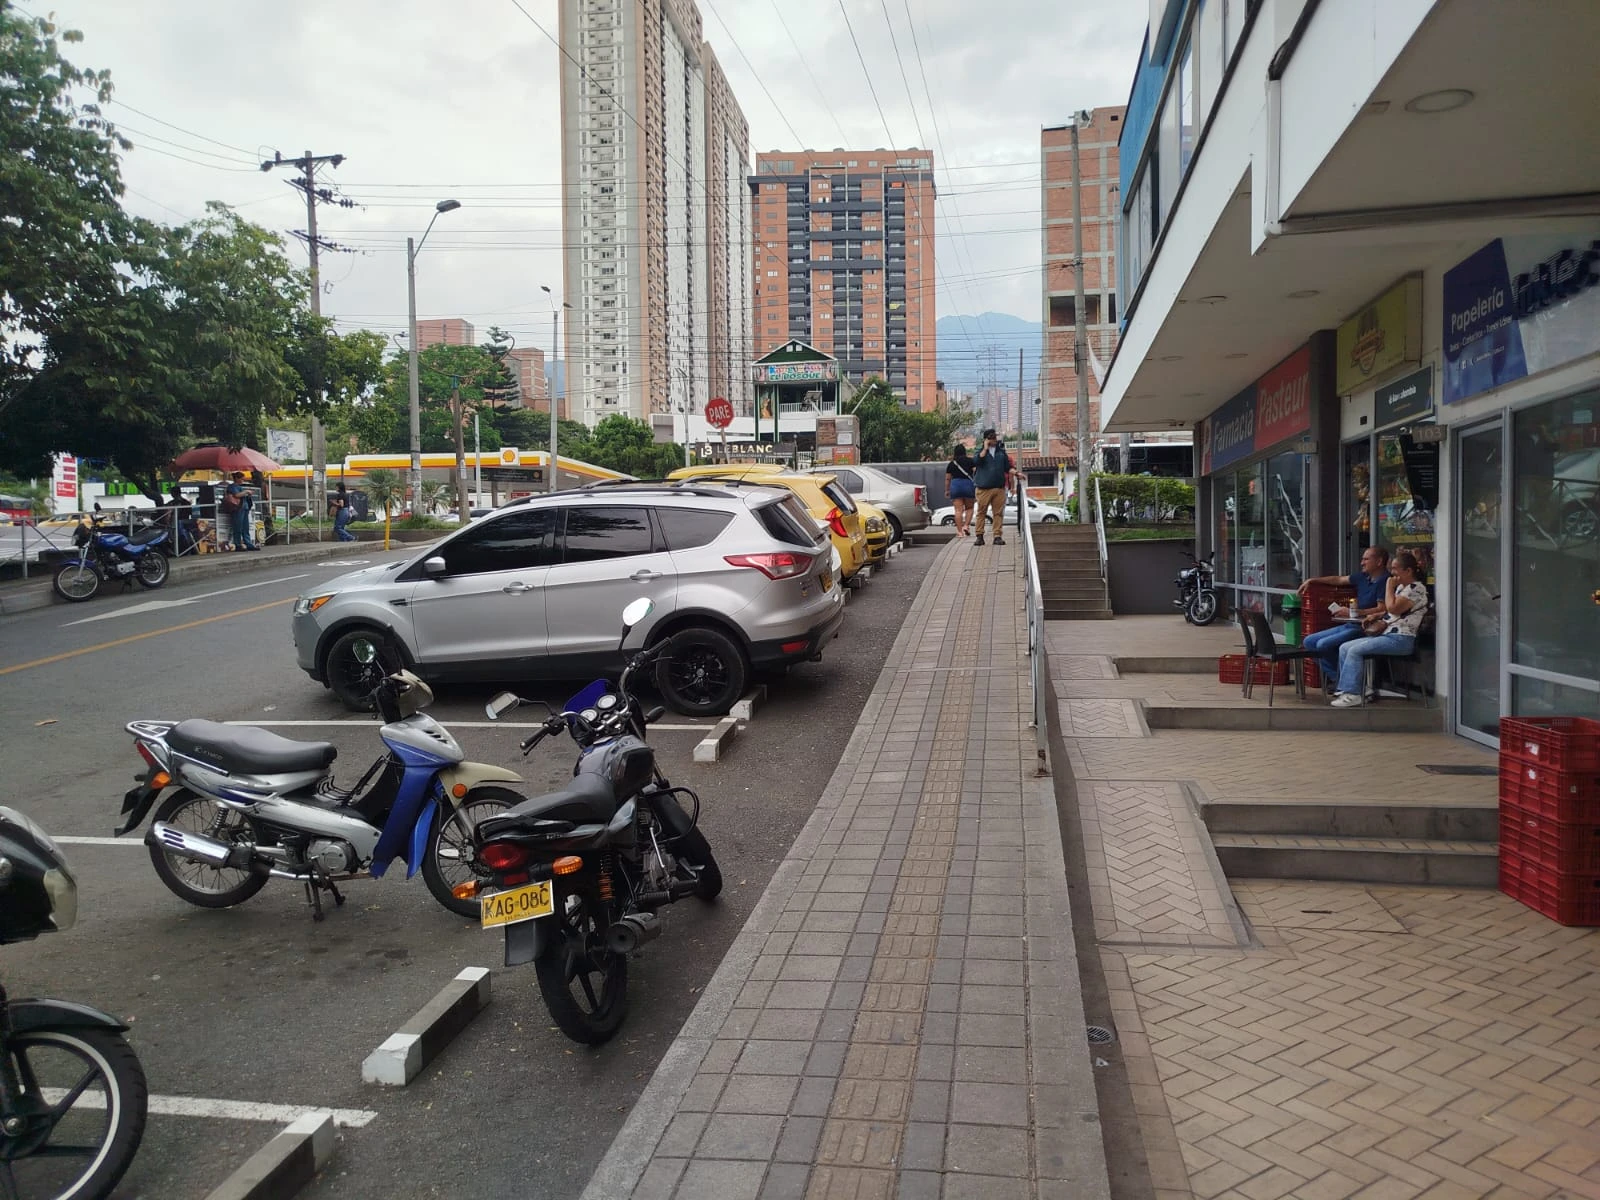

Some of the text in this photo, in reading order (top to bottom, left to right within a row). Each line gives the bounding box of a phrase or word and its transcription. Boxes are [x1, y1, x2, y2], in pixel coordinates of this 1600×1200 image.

[1451, 286, 1504, 336] Papelería
[783, 372, 821, 380] BOSQUE
[708, 404, 731, 422] PARE
[1213, 400, 1254, 456] Farmacia
[1258, 371, 1309, 430] Pasteur
[717, 443, 774, 454] LEBLANC
